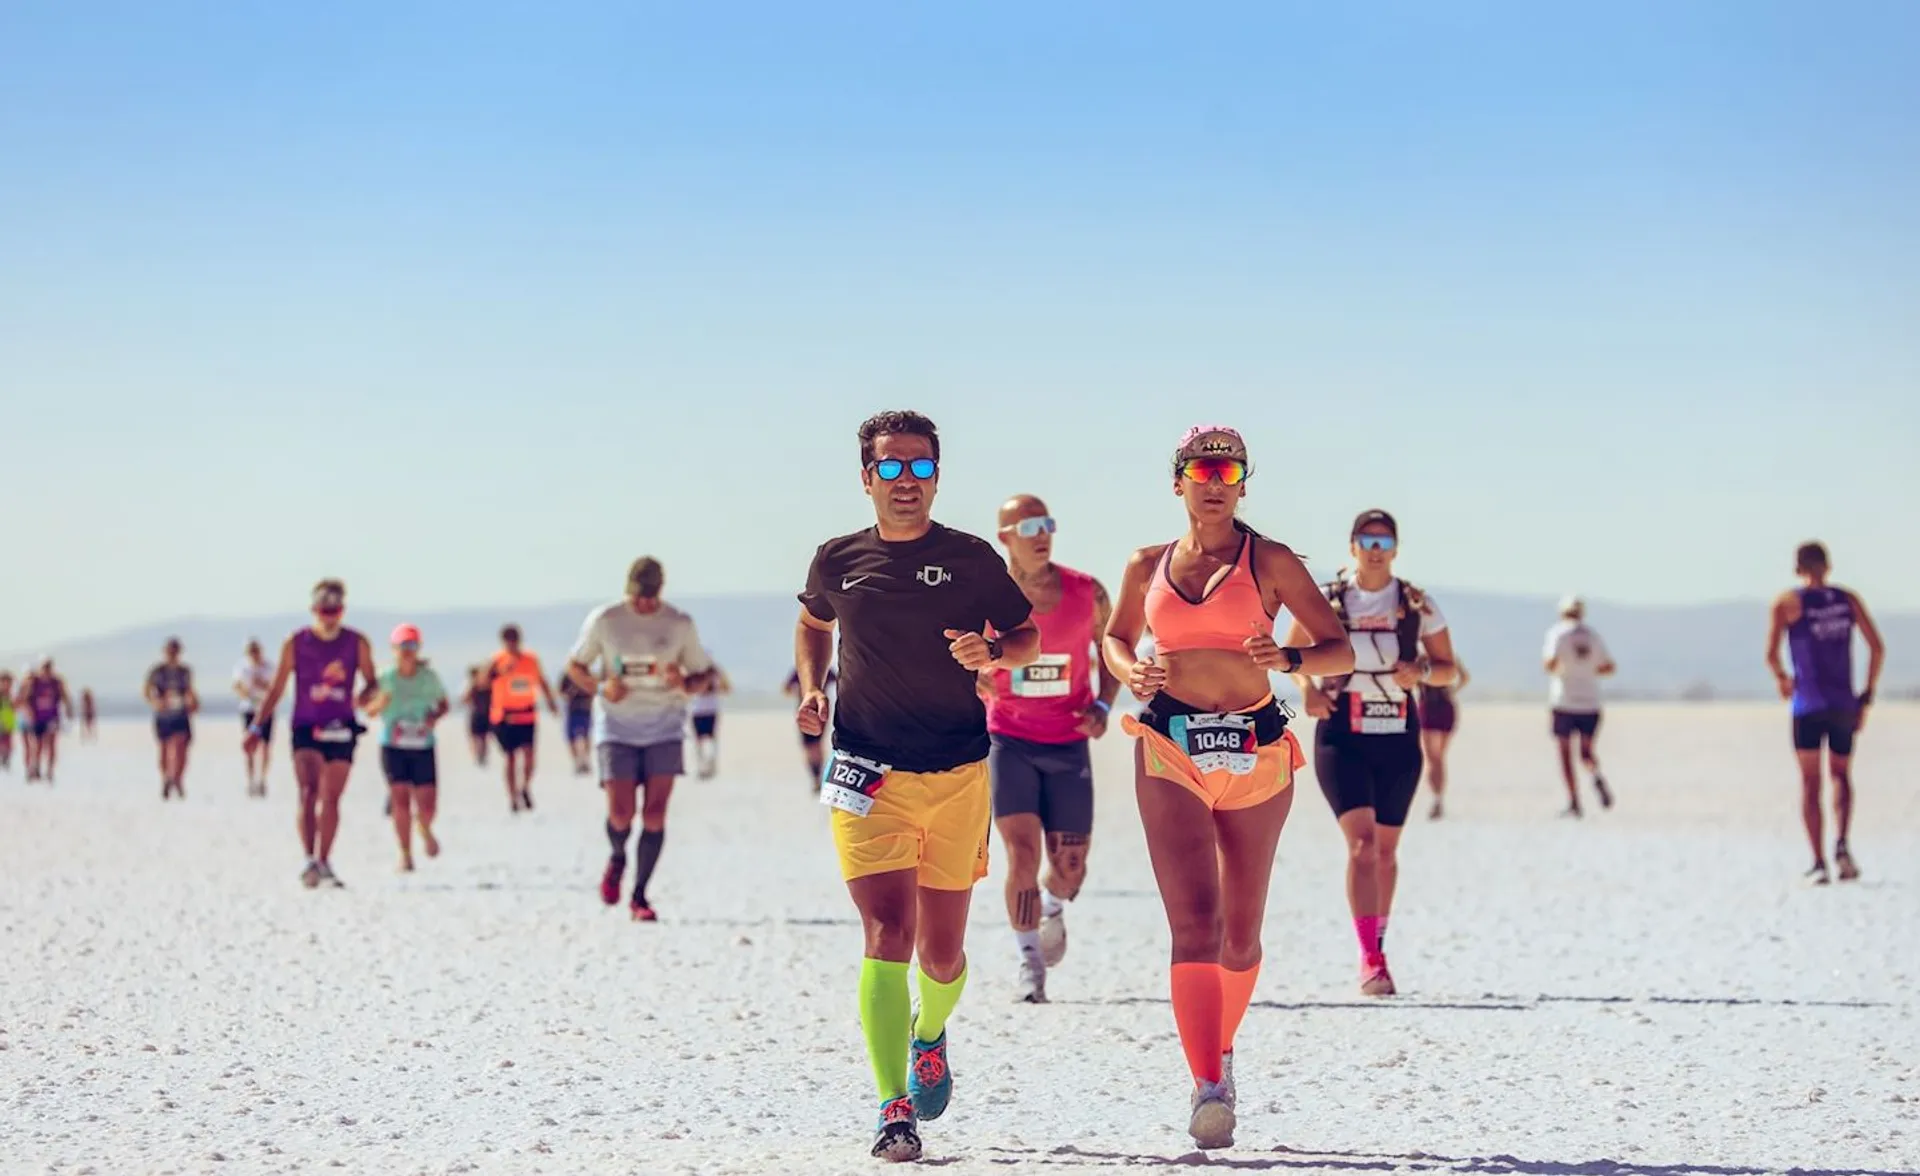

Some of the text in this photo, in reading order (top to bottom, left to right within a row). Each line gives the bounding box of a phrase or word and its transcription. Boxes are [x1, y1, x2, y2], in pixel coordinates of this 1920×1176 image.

[916, 565, 952, 587] RUN
[1365, 702, 1400, 717] 2004
[1195, 732, 1241, 750] 1048
[833, 763, 867, 788] 1261
